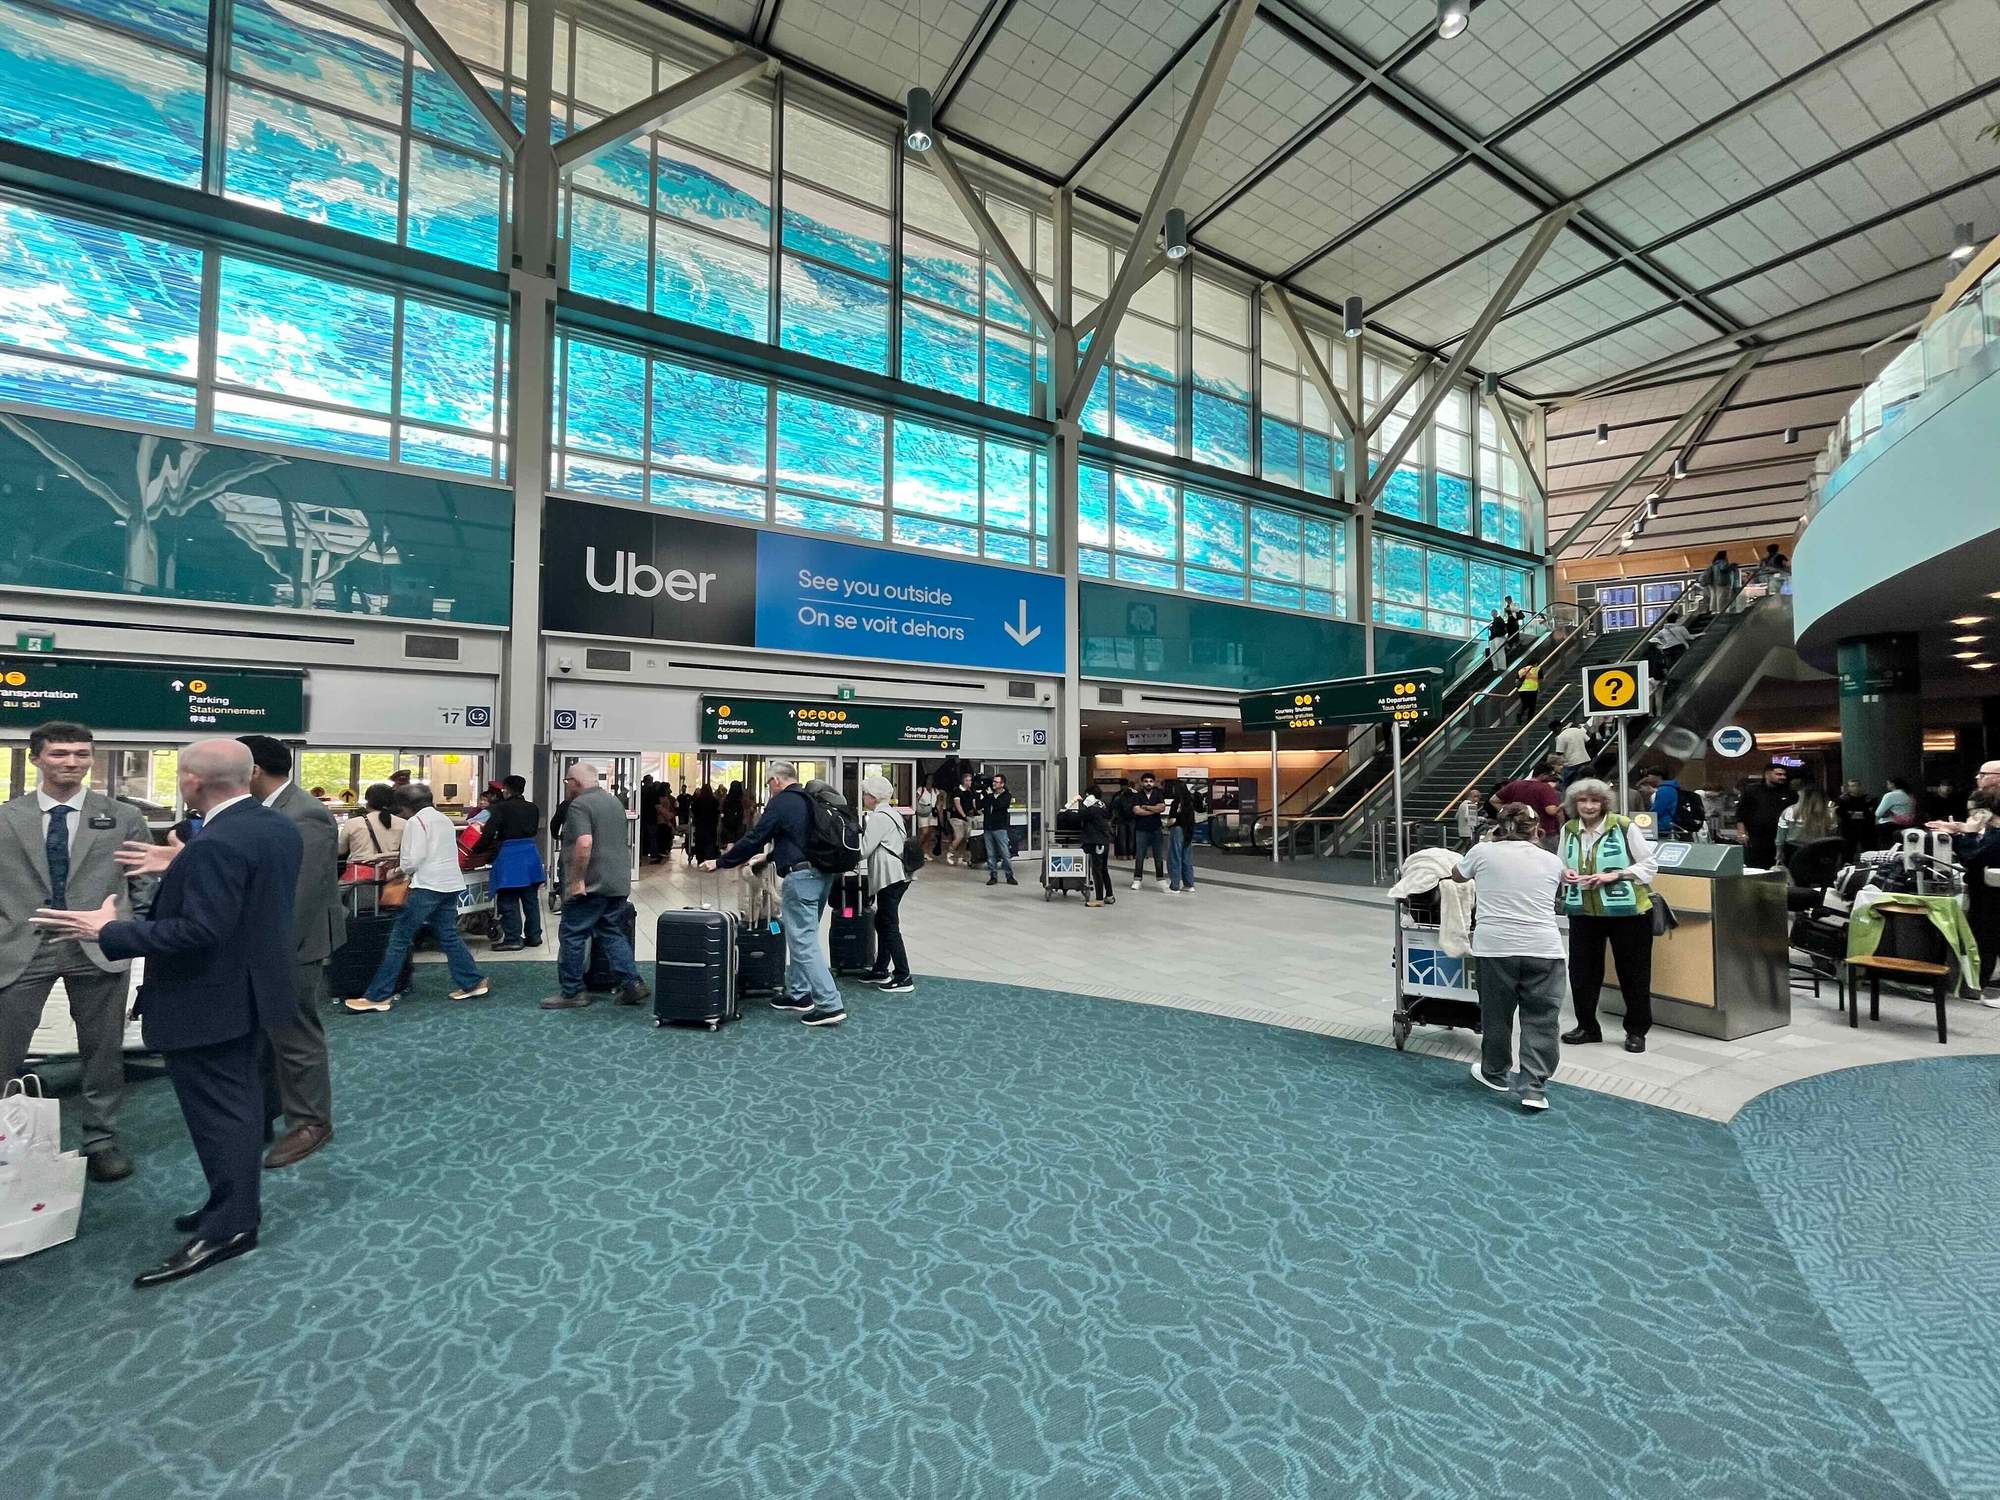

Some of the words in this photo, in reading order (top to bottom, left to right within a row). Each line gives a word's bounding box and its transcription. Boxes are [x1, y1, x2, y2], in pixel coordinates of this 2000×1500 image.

[585, 546, 717, 603] Uber
[798, 569, 839, 591] See
[843, 579, 880, 598] you
[883, 585, 953, 606] outside
[798, 606, 830, 627] On
[834, 614, 858, 630] se
[862, 616, 898, 634] voit
[901, 619, 965, 641] dehors
[0, 689, 78, 698] ansportation
[22, 700, 41, 708] sol
[188, 695, 230, 706] Parking
[189, 705, 265, 715] Stationnement
[442, 712, 460, 725] 17
[471, 713, 484, 721] L2
[559, 717, 572, 725] L2
[582, 718, 598, 729] 17
[1021, 734, 1031, 743] 17
[1051, 862, 1083, 873] YVR
